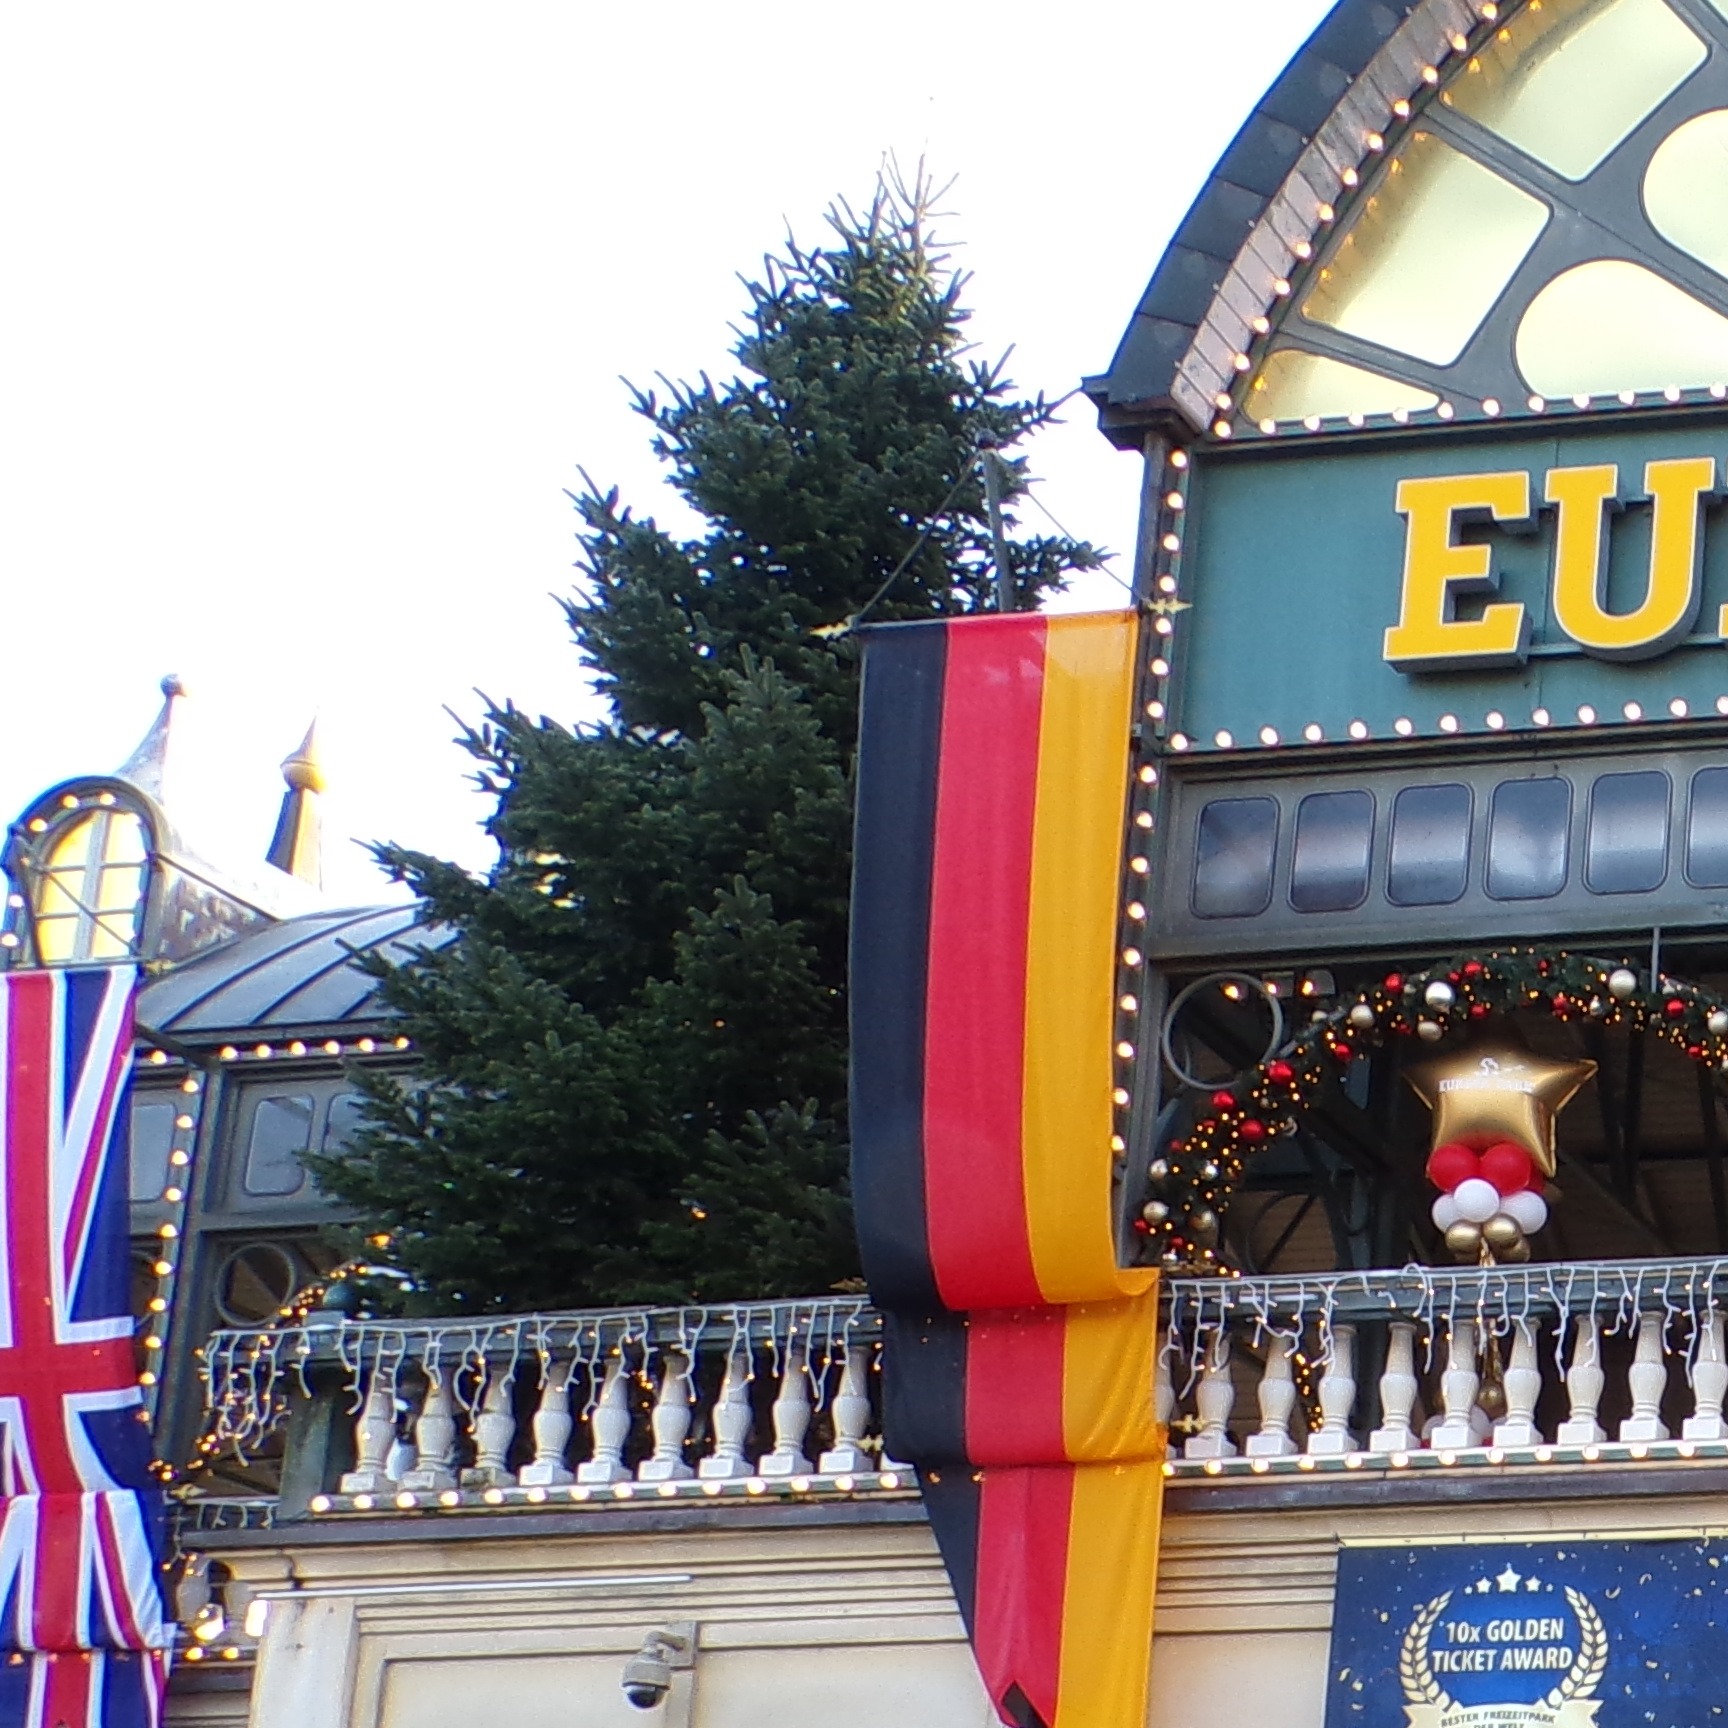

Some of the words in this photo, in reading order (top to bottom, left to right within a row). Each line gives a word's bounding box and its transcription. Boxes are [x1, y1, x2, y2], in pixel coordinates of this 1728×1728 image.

[1446, 1622, 1482, 1643] 10x
[1486, 1618, 1564, 1642] GOLDEN
[1432, 1649, 1498, 1673] TICKET
[1500, 1647, 1573, 1671] AWARD
